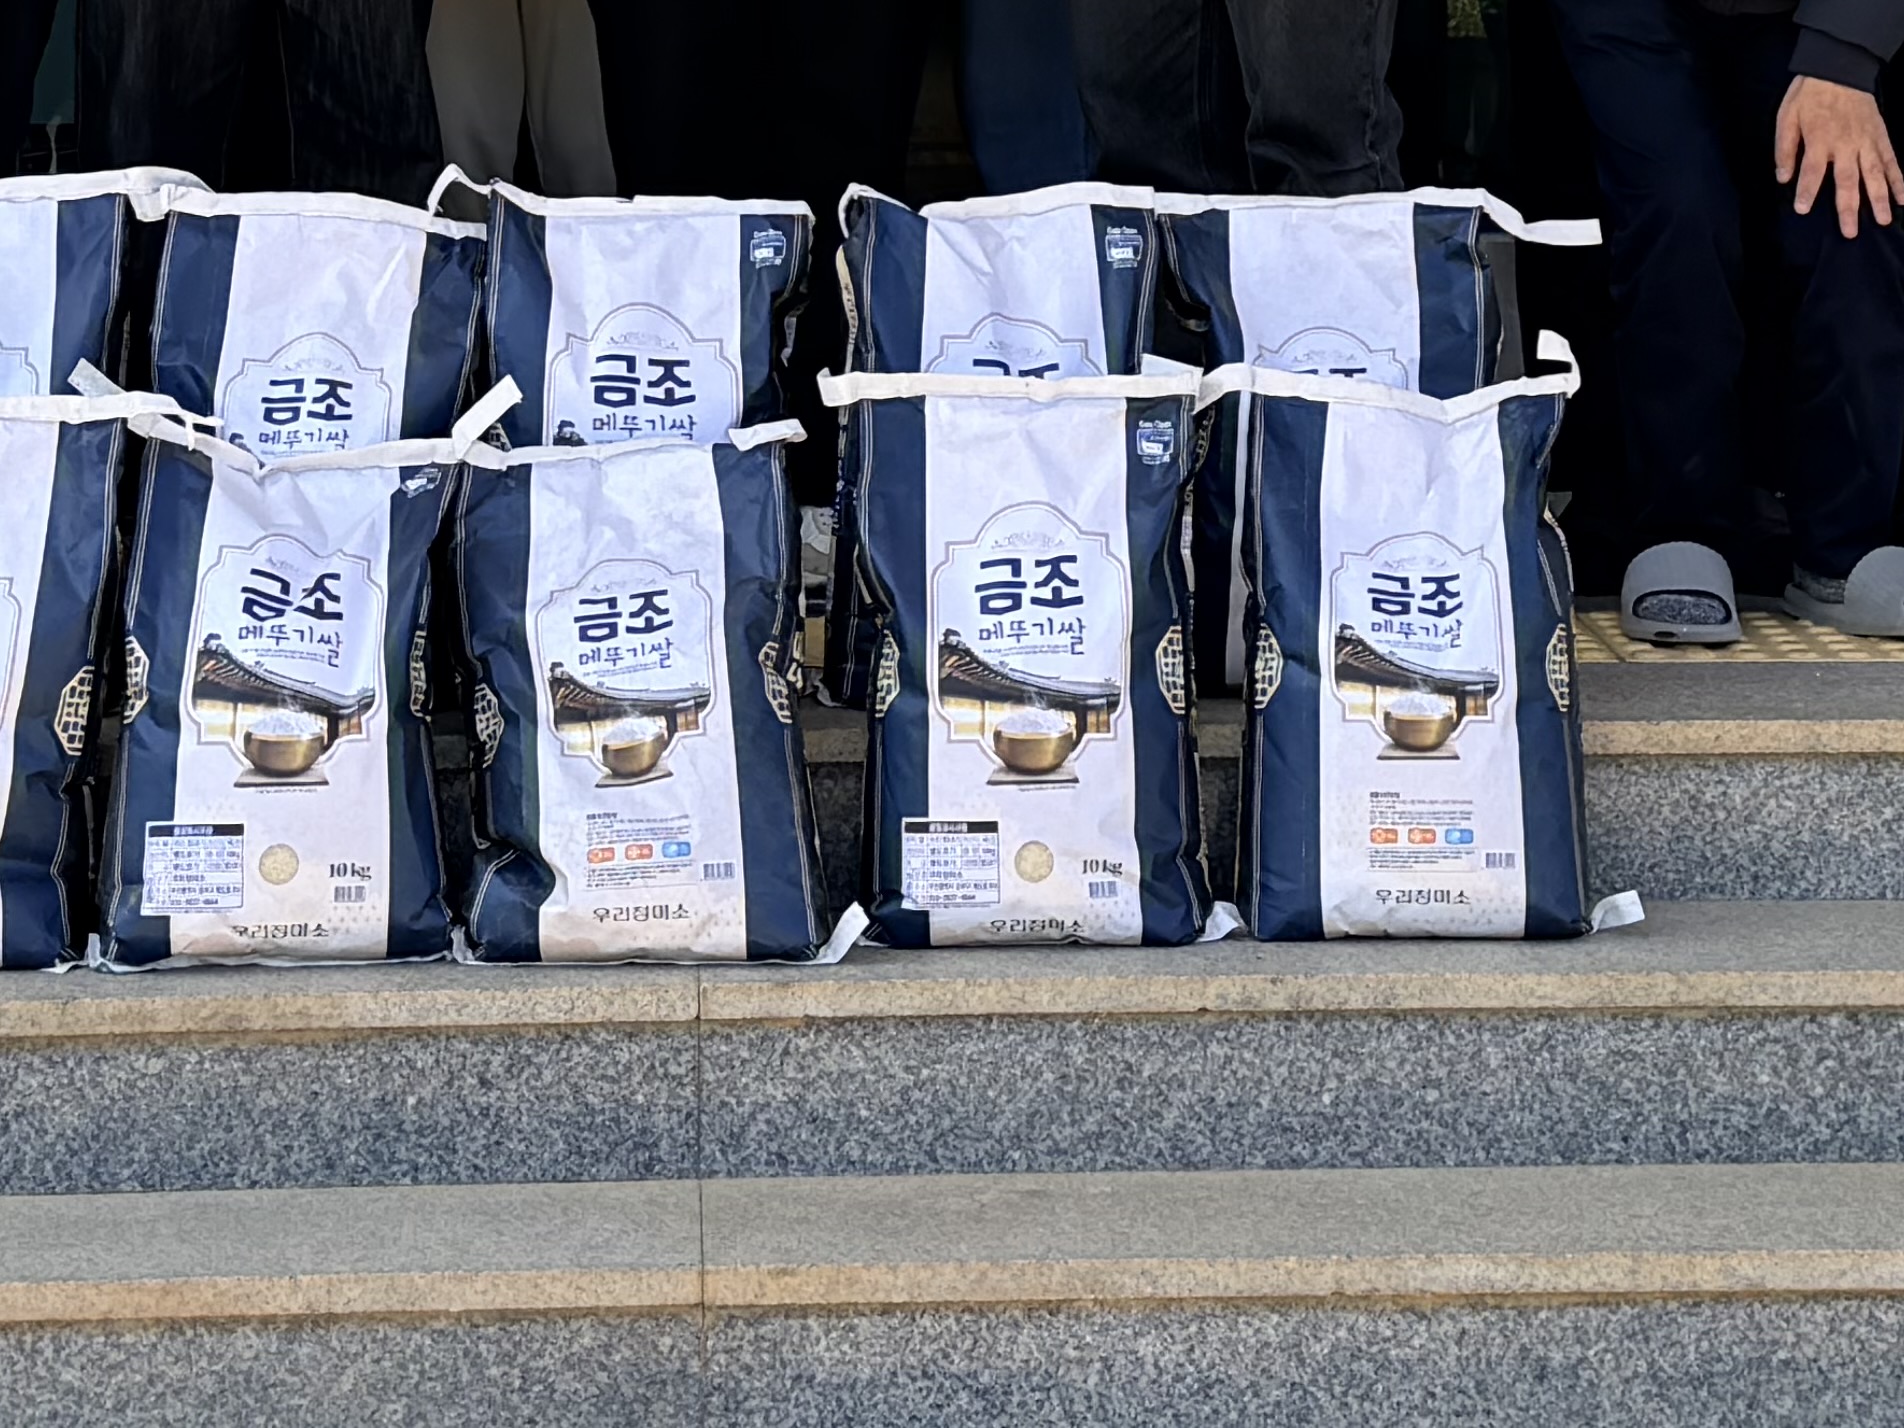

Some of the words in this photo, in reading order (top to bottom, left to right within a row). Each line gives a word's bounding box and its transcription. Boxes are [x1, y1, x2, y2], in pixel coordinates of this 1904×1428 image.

[261, 378, 353, 425] 금조
[590, 354, 696, 408] 금조
[240, 567, 343, 622] 금조
[974, 554, 1084, 615] 금조
[1367, 572, 1463, 618] 금조
[573, 589, 673, 642] 금조
[978, 617, 1086, 655] 메뚜기쌀
[1371, 619, 1463, 648] 메뚜기쌀
[238, 624, 343, 668] 메뚜기쌀
[578, 637, 674, 669] 메뚜기쌀
[593, 904, 690, 923] 우리정미소
[1375, 889, 1471, 905] 우리정미소
[231, 922, 329, 939] 우리정미소
[990, 918, 1085, 933] 우리정미소
